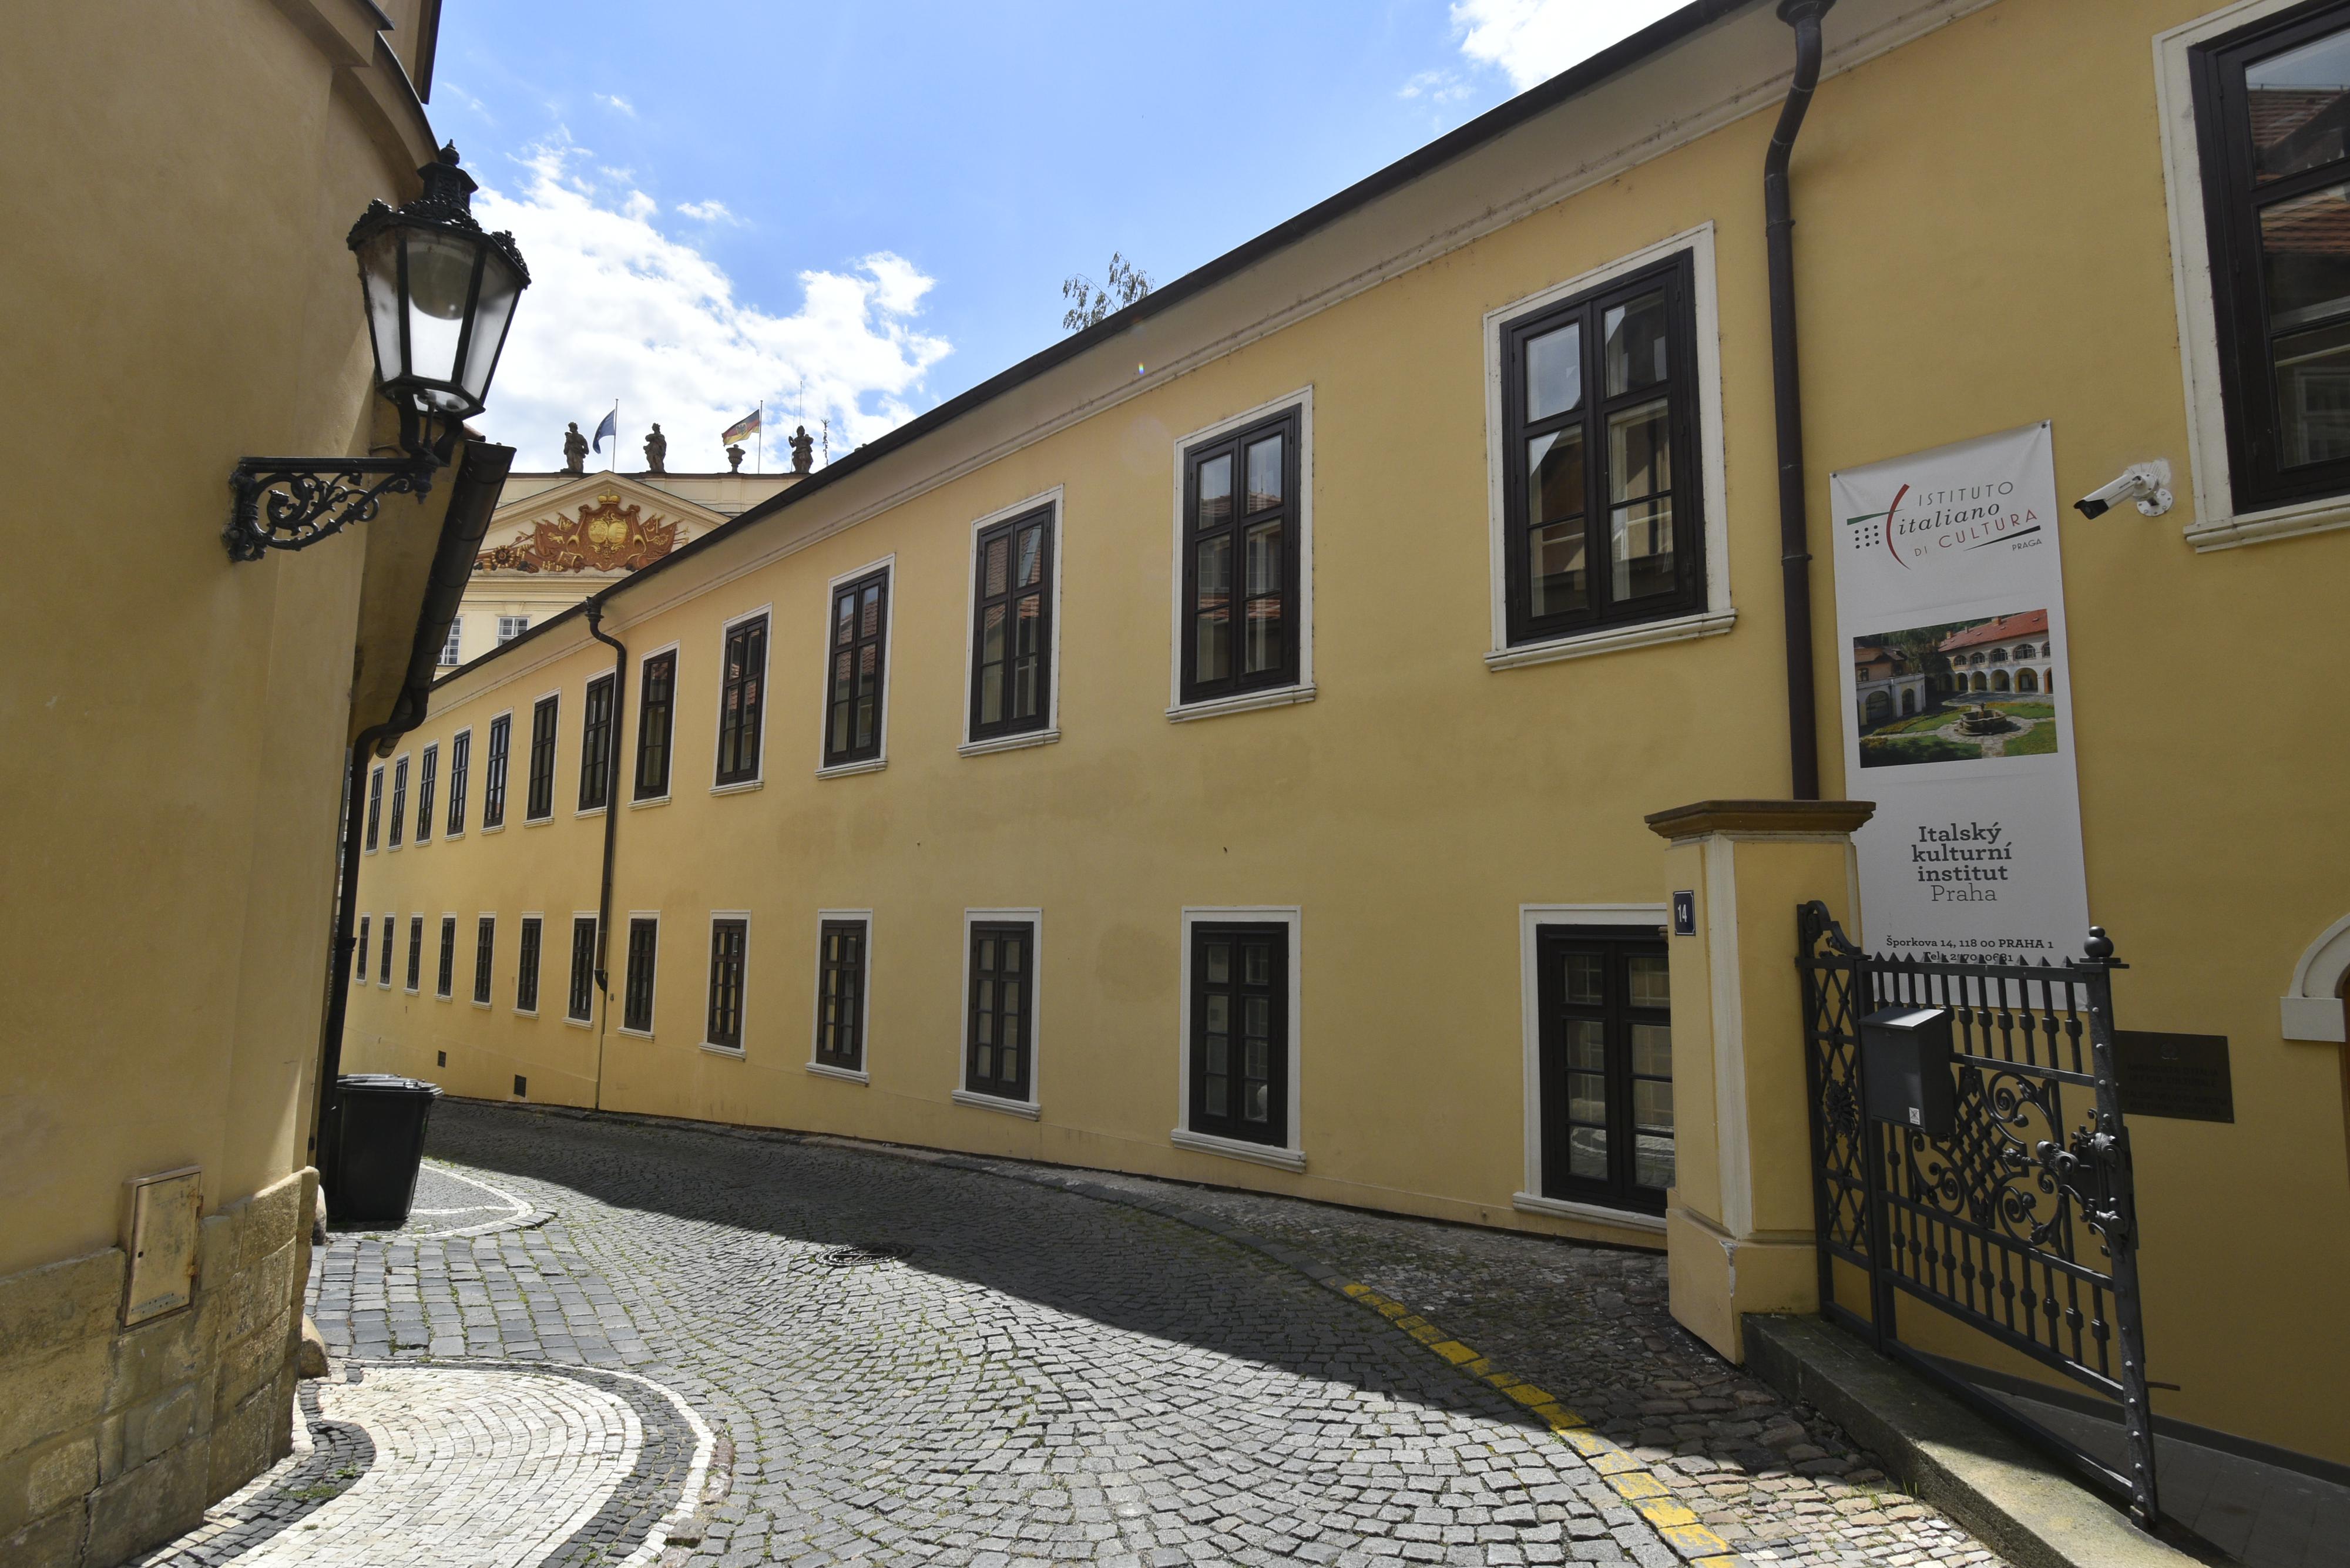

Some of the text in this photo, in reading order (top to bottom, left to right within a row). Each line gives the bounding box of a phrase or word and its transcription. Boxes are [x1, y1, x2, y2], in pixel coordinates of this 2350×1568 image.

[1918, 481, 2013, 506] ISTITUTO
[1899, 503, 2000, 535] italiano
[1914, 509, 2037, 557] DI CULTURA
[2012, 538, 2042, 551] PRAGA
[1918, 822, 2002, 844] Italský
[1911, 842, 2012, 862] kulturní
[1918, 865, 2008, 882] institut
[1931, 882, 1998, 902] Praha
[1677, 904, 1687, 922] 14
[1886, 935, 1938, 948] Šporkova
[1940, 939, 1956, 948] 14,
[1959, 939, 1978, 948] 118
[1998, 939, 2045, 949] PRAHA
